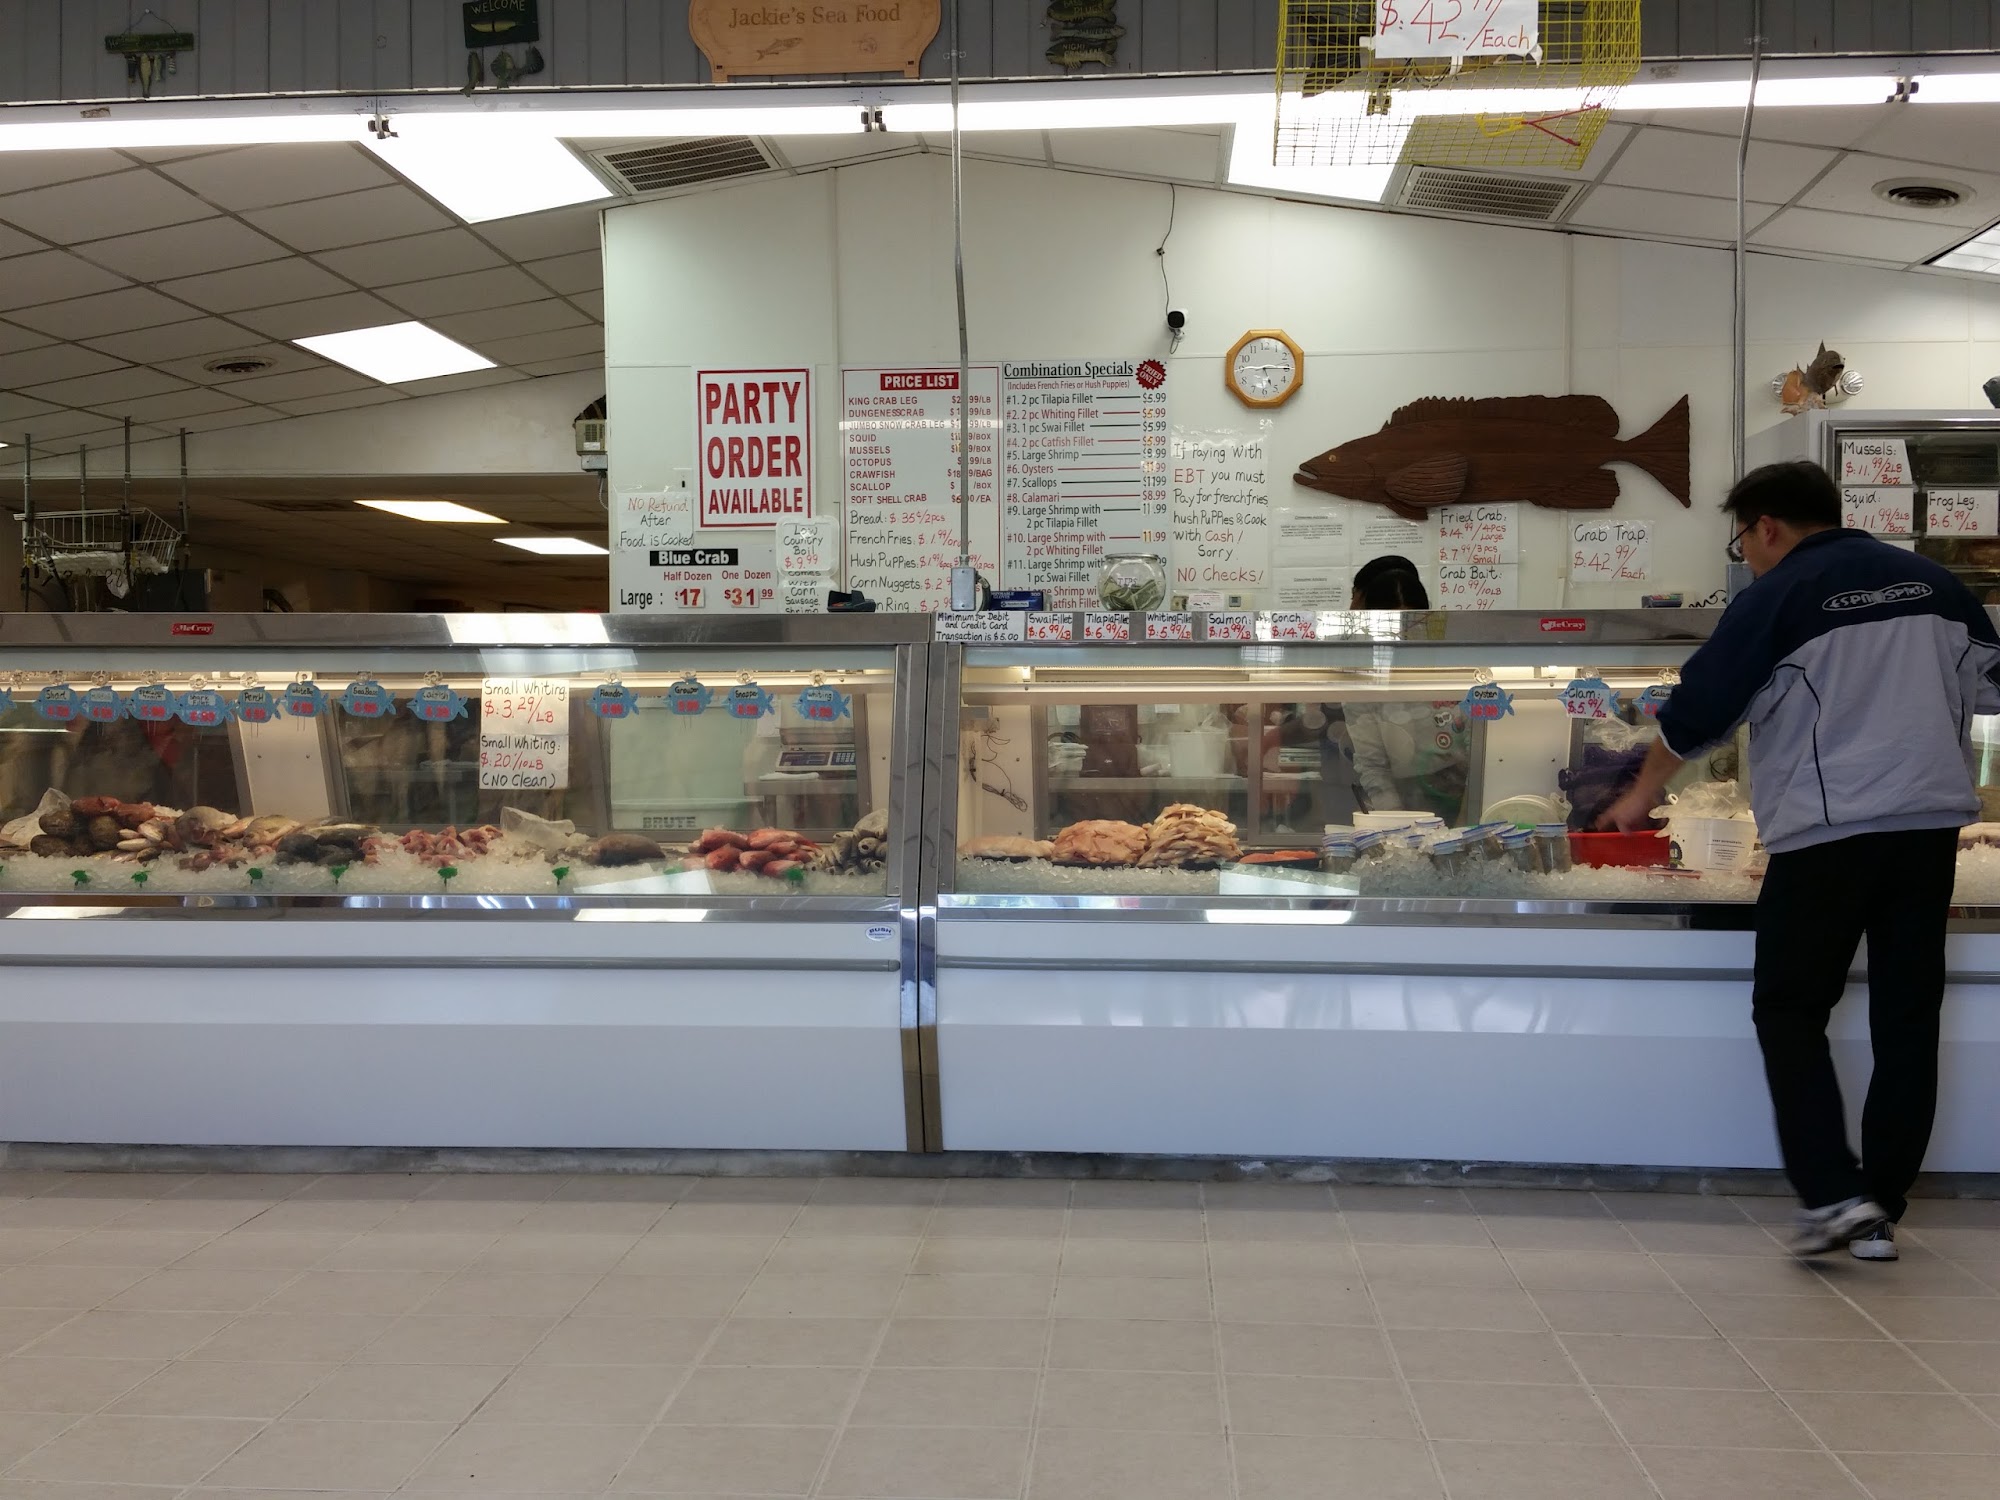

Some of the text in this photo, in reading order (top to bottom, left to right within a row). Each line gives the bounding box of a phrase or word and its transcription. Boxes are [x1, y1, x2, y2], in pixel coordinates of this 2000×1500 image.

[470, 0, 525, 14] WELCOME
[729, 4, 901, 28] Jackie's Sea Food
[1004, 361, 1134, 378] Combination Specials
[1142, 364, 1163, 380] FRIED
[884, 375, 954, 388] PRICE LIST
[1140, 371, 1159, 386] ONLY
[1008, 380, 1130, 391] (Includes French Fries Hush Puppies)
[706, 382, 801, 424] PARTY
[848, 396, 918, 406] KING CRAB LEG
[1041, 392, 1166, 406] Tilapia Fillet $5.99
[1041, 408, 1166, 421] Whiting Fillet $5.99
[850, 420, 945, 430] JUMBO SNOW CRAB LEG
[1042, 421, 1166, 432] Swai Fillet $5.99
[850, 434, 876, 442] SQUID
[1042, 436, 1166, 448] Catfish Fillet $5.99
[850, 446, 891, 454] MUSSELS
[1022, 449, 1079, 462] Large Shrimp
[1174, 440, 1226, 464] If Paying
[1844, 442, 1896, 456] Mussels:
[708, 436, 802, 478] ORDER
[850, 458, 892, 466] OCTOPUS
[850, 470, 896, 479] CRAWFISH
[1022, 464, 1054, 476] Oysters
[1174, 468, 1265, 484] EBT you must
[1022, 477, 1057, 489] Scallops
[1882, 474, 1900, 484] Box
[850, 483, 891, 491] SCALLOP
[708, 488, 803, 514] AVAILABLE
[851, 494, 927, 504] SOFT SHELL CRAB
[1022, 490, 1166, 503] Calamari $8.99
[1173, 488, 1212, 507] Pay for
[1929, 492, 1953, 512] Frog
[628, 497, 688, 513] NO Refund
[1022, 505, 1046, 518] Large
[1048, 504, 1080, 517] Shrimp
[1081, 504, 1100, 514] with
[640, 512, 672, 527] After
[1173, 510, 1267, 526] hush Cook
[1440, 508, 1474, 524] Fried
[1046, 518, 1098, 530] Tilapia Fillet
[1888, 522, 1906, 533] Box
[849, 530, 885, 545] French
[1007, 530, 1166, 546] #10. Large Shrimp with 11.99
[1173, 528, 1201, 542] with
[1481, 532, 1504, 542] Large
[1574, 523, 1607, 542] Crab
[650, 534, 659, 546] is
[660, 532, 694, 548] Cooked
[783, 536, 824, 547] Country
[793, 545, 815, 556] Boil
[1046, 544, 1103, 557] Whiting Fillet
[658, 550, 730, 566] Blue Crab
[850, 553, 876, 568] Hush
[1007, 557, 1106, 572] #11. Large Shrimp with
[1472, 554, 1501, 564] Small
[664, 570, 771, 581] Half Dozen One Dozen
[1046, 571, 1090, 582] Swai Fillet
[1177, 568, 1196, 582] NO
[1440, 566, 1466, 579] Crab
[850, 575, 878, 590] Corn
[620, 588, 701, 609] Large $17
[1053, 586, 1084, 598] Shrimp
[886, 597, 910, 612] Ring
[1080, 598, 1100, 609] Fillet
[937, 612, 1010, 621] Minimum Debit
[1029, 613, 1072, 624] Swai Fillet
[1086, 613, 1115, 625] Tilapia
[1147, 613, 1177, 625] Whiting
[945, 621, 1008, 630] and Credit Card
[1550, 620, 1585, 630] McCray
[936, 631, 982, 641] Transaction
[485, 680, 518, 695] Small
[1568, 688, 1600, 699] Clam:
[46, 690, 66, 700] Shad
[482, 735, 560, 755] Small Whiting:
[512, 772, 555, 789] Clean)
[642, 816, 696, 829] BRUTE
